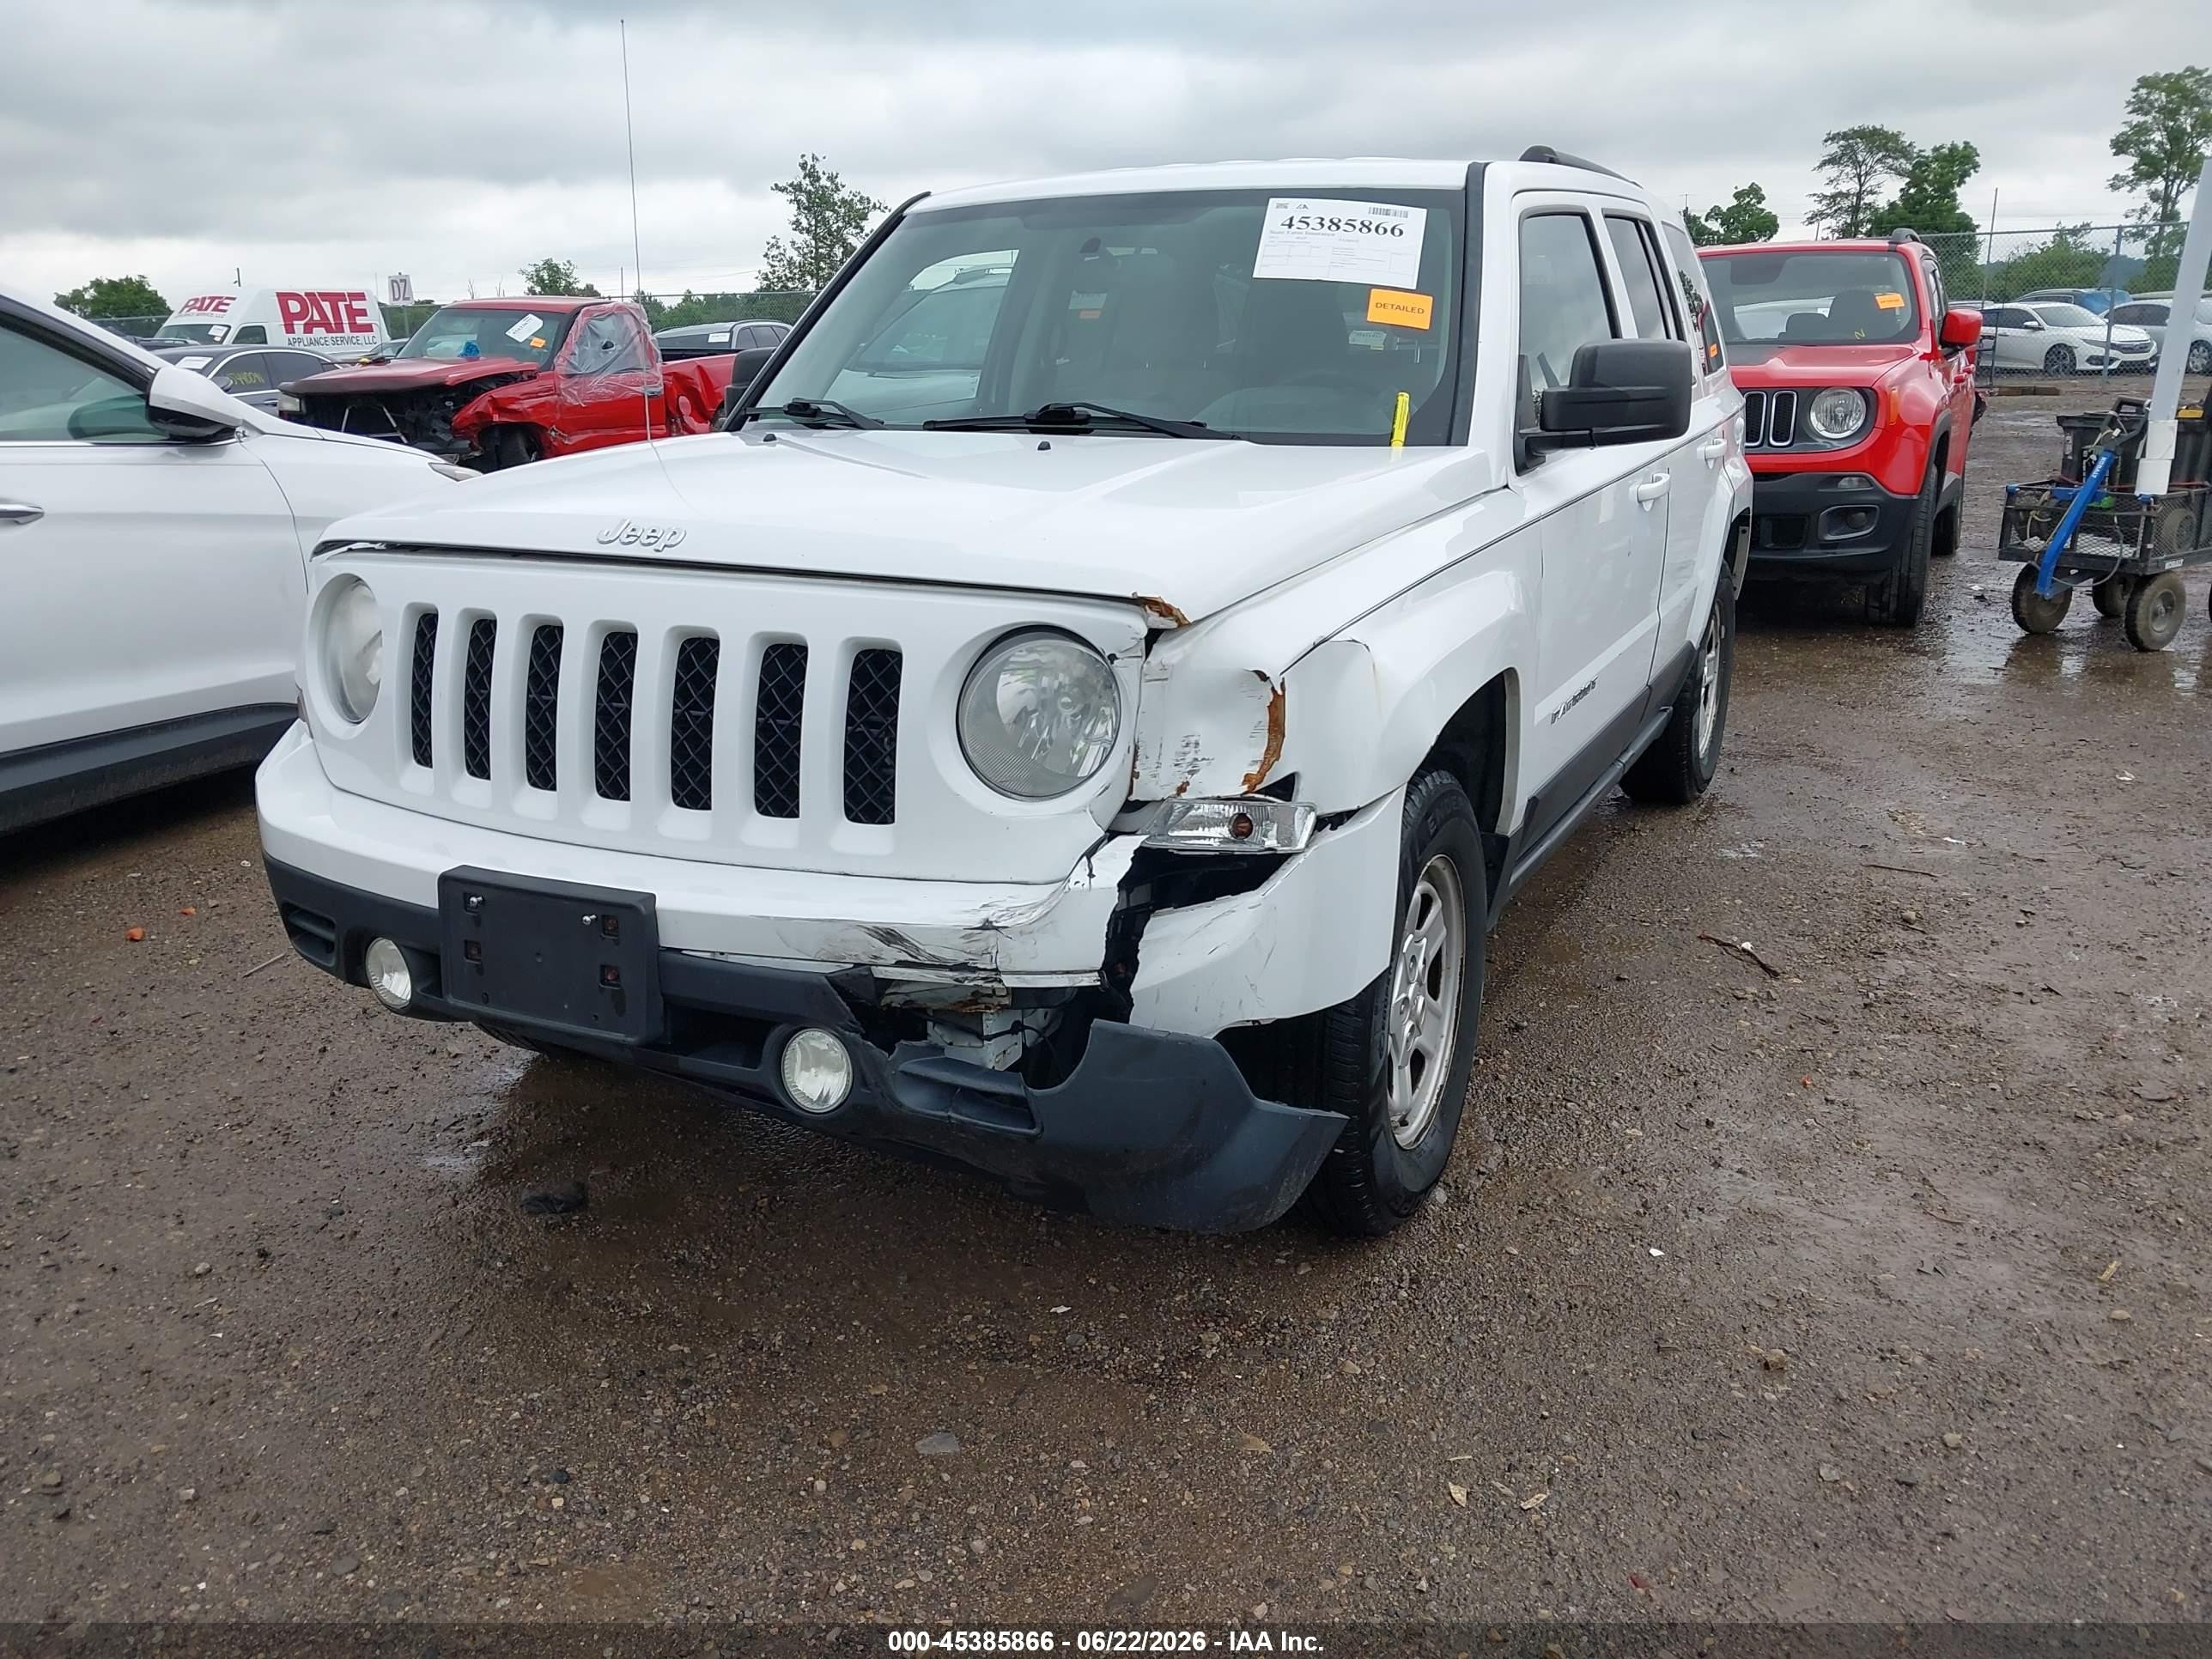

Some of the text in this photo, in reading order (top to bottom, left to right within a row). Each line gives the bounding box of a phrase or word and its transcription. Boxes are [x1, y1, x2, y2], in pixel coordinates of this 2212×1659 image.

[1280, 216, 1405, 238] 45385866
[391, 279, 410, 301] DZ
[179, 295, 237, 313] PATE
[276, 292, 374, 334] PATE
[1375, 302, 1425, 314] DETAILED
[288, 335, 377, 347] APPLIANCE SERVICE, LLC
[597, 518, 686, 552] Jeep
